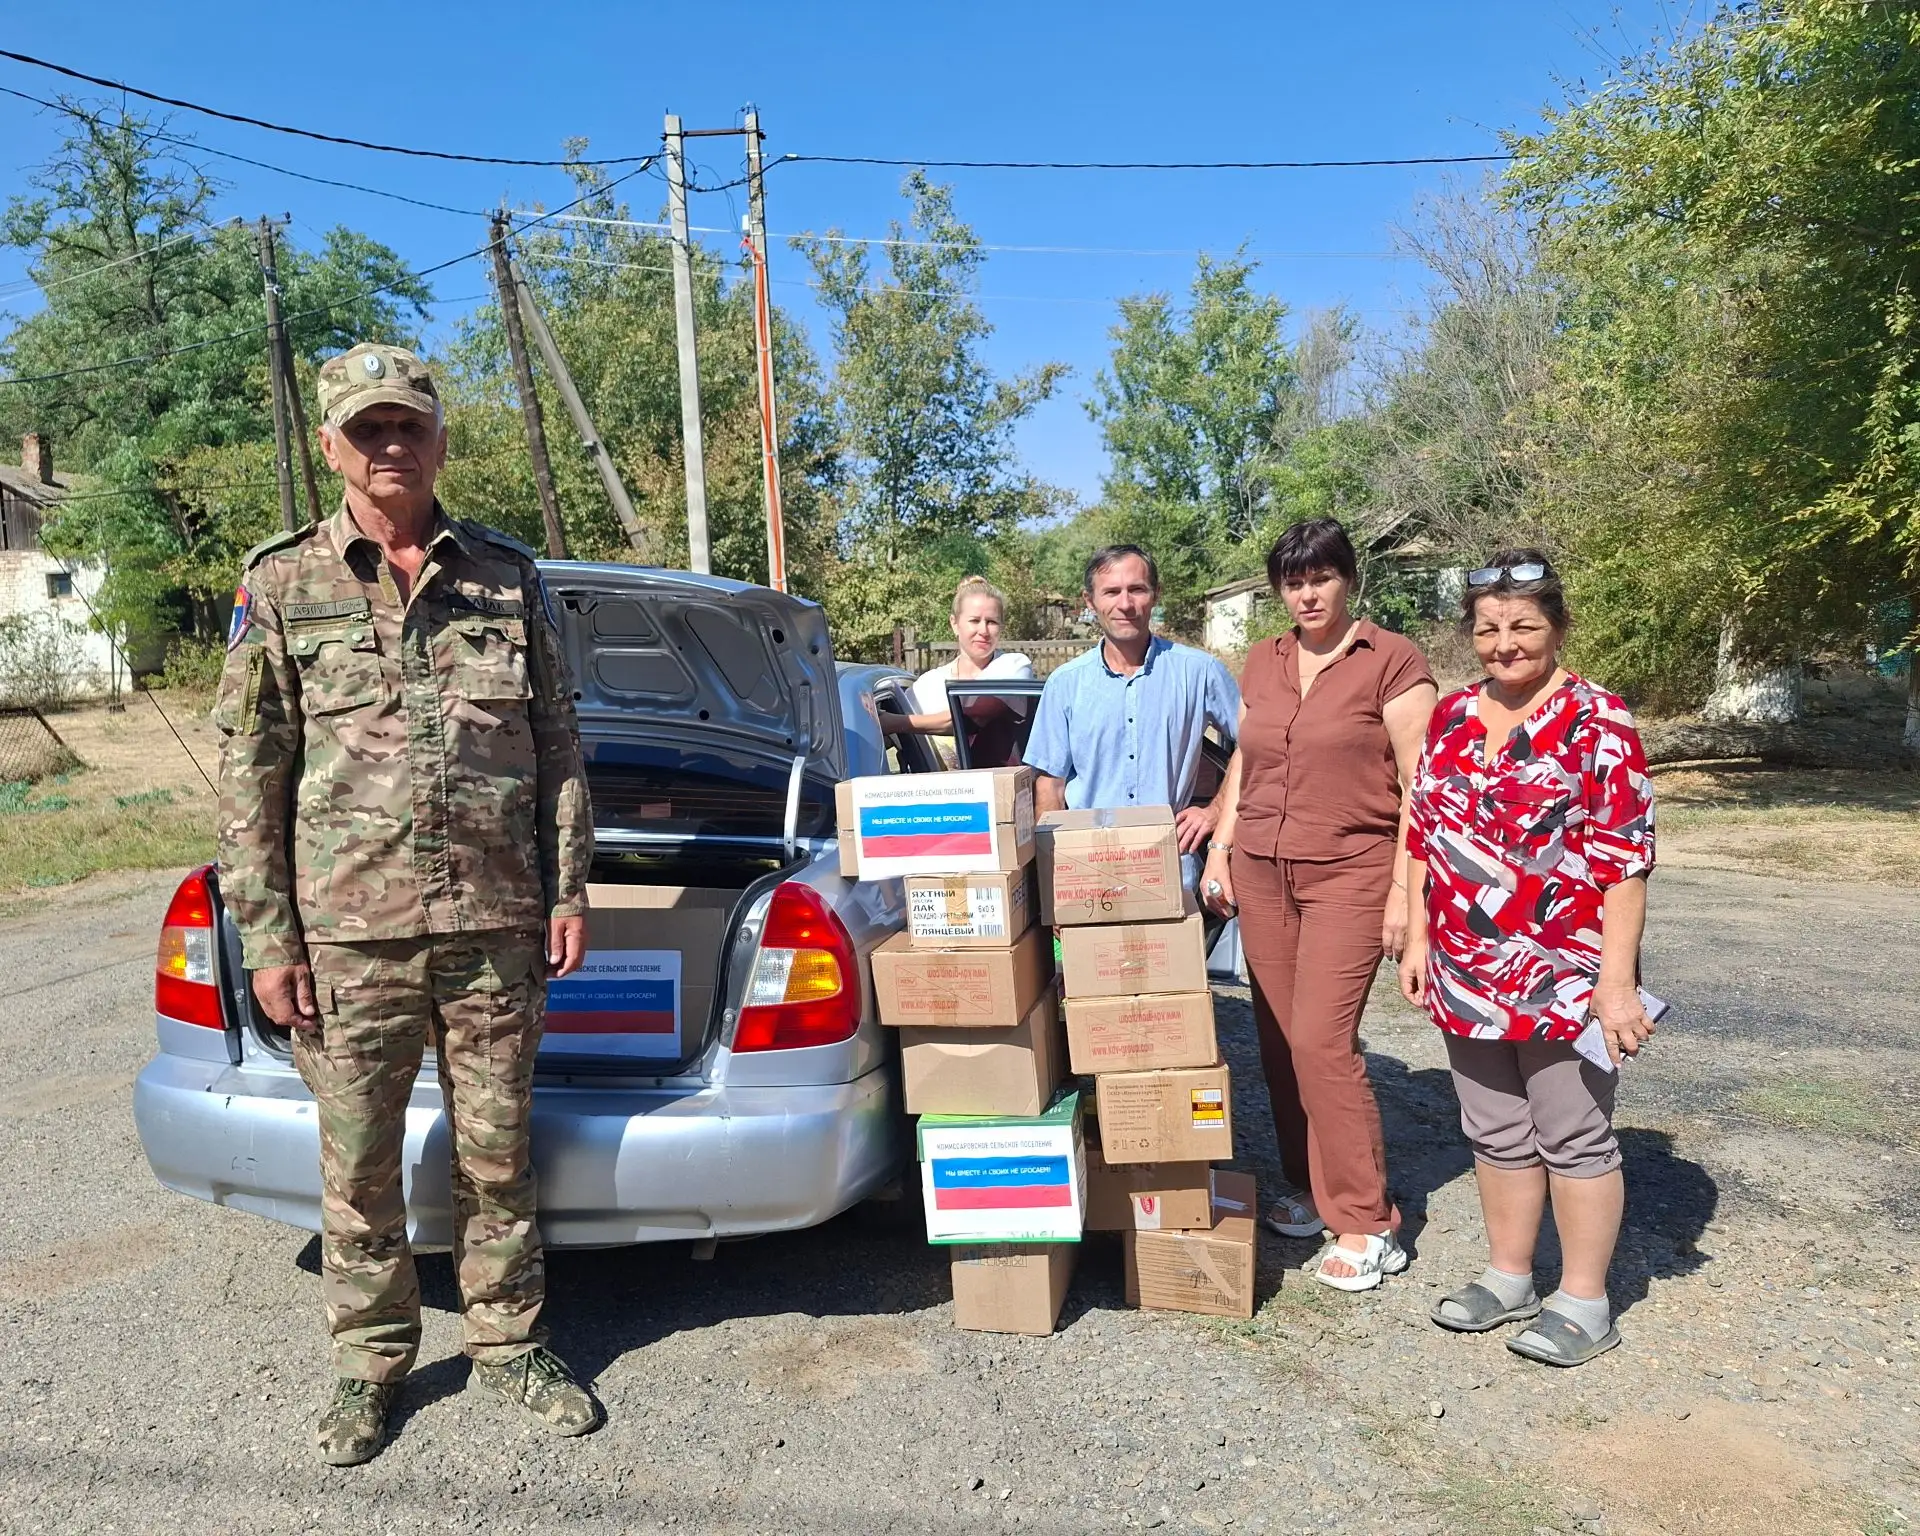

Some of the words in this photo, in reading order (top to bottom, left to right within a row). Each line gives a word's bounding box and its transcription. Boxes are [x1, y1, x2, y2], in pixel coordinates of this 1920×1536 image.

[915, 789, 942, 797] СЕЛЬСКОЕ
[943, 788, 975, 796] ПОСЕЛЕНИЕ
[883, 817, 906, 825] ВМЕСТЕ
[913, 816, 933, 824] СВОИХ
[1088, 848, 1160, 863] www.kdv-group.com
[911, 890, 956, 898] ЯХТНЫЙ
[913, 904, 935, 912] ЛАК
[915, 927, 975, 936] ГЛЯНЦЕВЫЙ
[598, 965, 628, 973] СЕЛЬСКОЕ
[628, 965, 661, 973] ПОСЕЛЕНИЕ
[990, 1141, 1018, 1149] СЕЛЬСКОЕ
[1020, 1140, 1053, 1148] ПОСЕЛЕНИЕ
[957, 1169, 981, 1177] ВМЕСТЕ
[988, 1168, 1009, 1176] СВОИХ
[1010, 1167, 1019, 1175] НЕ
